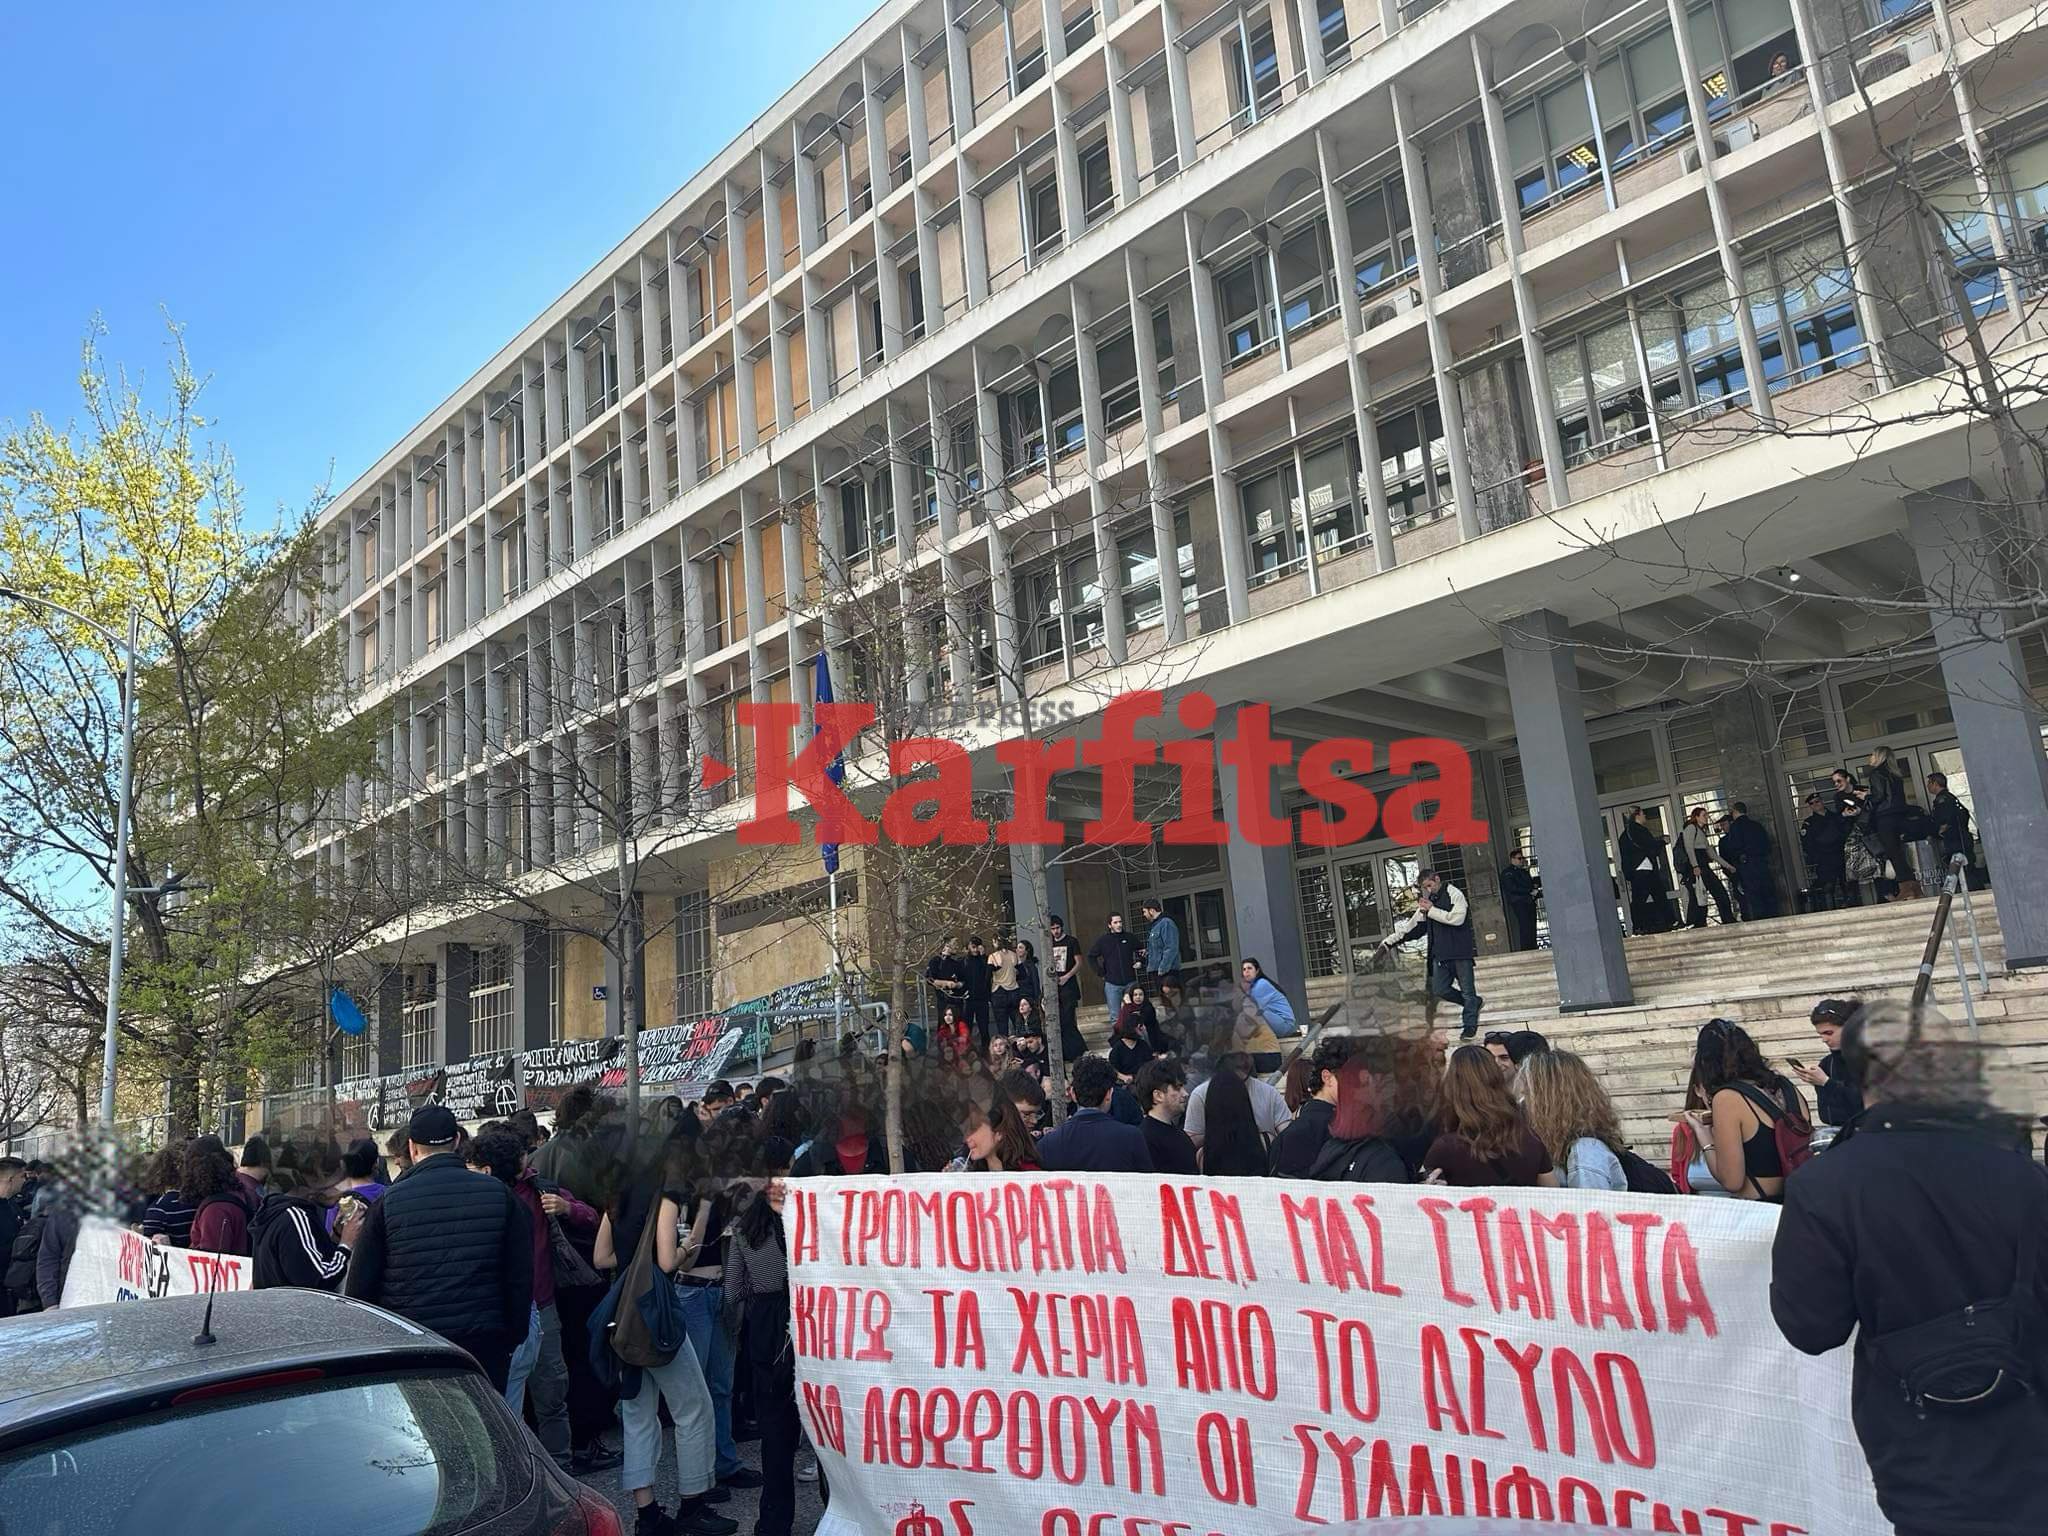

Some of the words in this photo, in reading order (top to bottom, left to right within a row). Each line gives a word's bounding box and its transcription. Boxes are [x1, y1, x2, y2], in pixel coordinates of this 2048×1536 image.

[793, 1188, 818, 1265] Η
[838, 1178, 1125, 1274] ΤΡΟΜΟΚΡΑΤΙΑ
[1158, 1182, 1257, 1282] ΔΕΝ
[1279, 1192, 1402, 1297] ΜΑΣ
[1417, 1196, 1718, 1338] ΣΤΑΜΑΤΑ
[794, 1285, 893, 1361] ΚΑΤΩ
[922, 1289, 986, 1370] ΤΑ
[1006, 1287, 1148, 1387] ΧΕΡΙΑ
[1171, 1296, 1277, 1401] ΑΠΟ
[1297, 1308, 1381, 1423] ΤΟ
[1419, 1323, 1655, 1468] ΑΣΥΛΟ
[862, 1385, 1166, 1497] ΑΘΩΩΘΟΥΝ
[1195, 1411, 1257, 1506] ΟΙ
